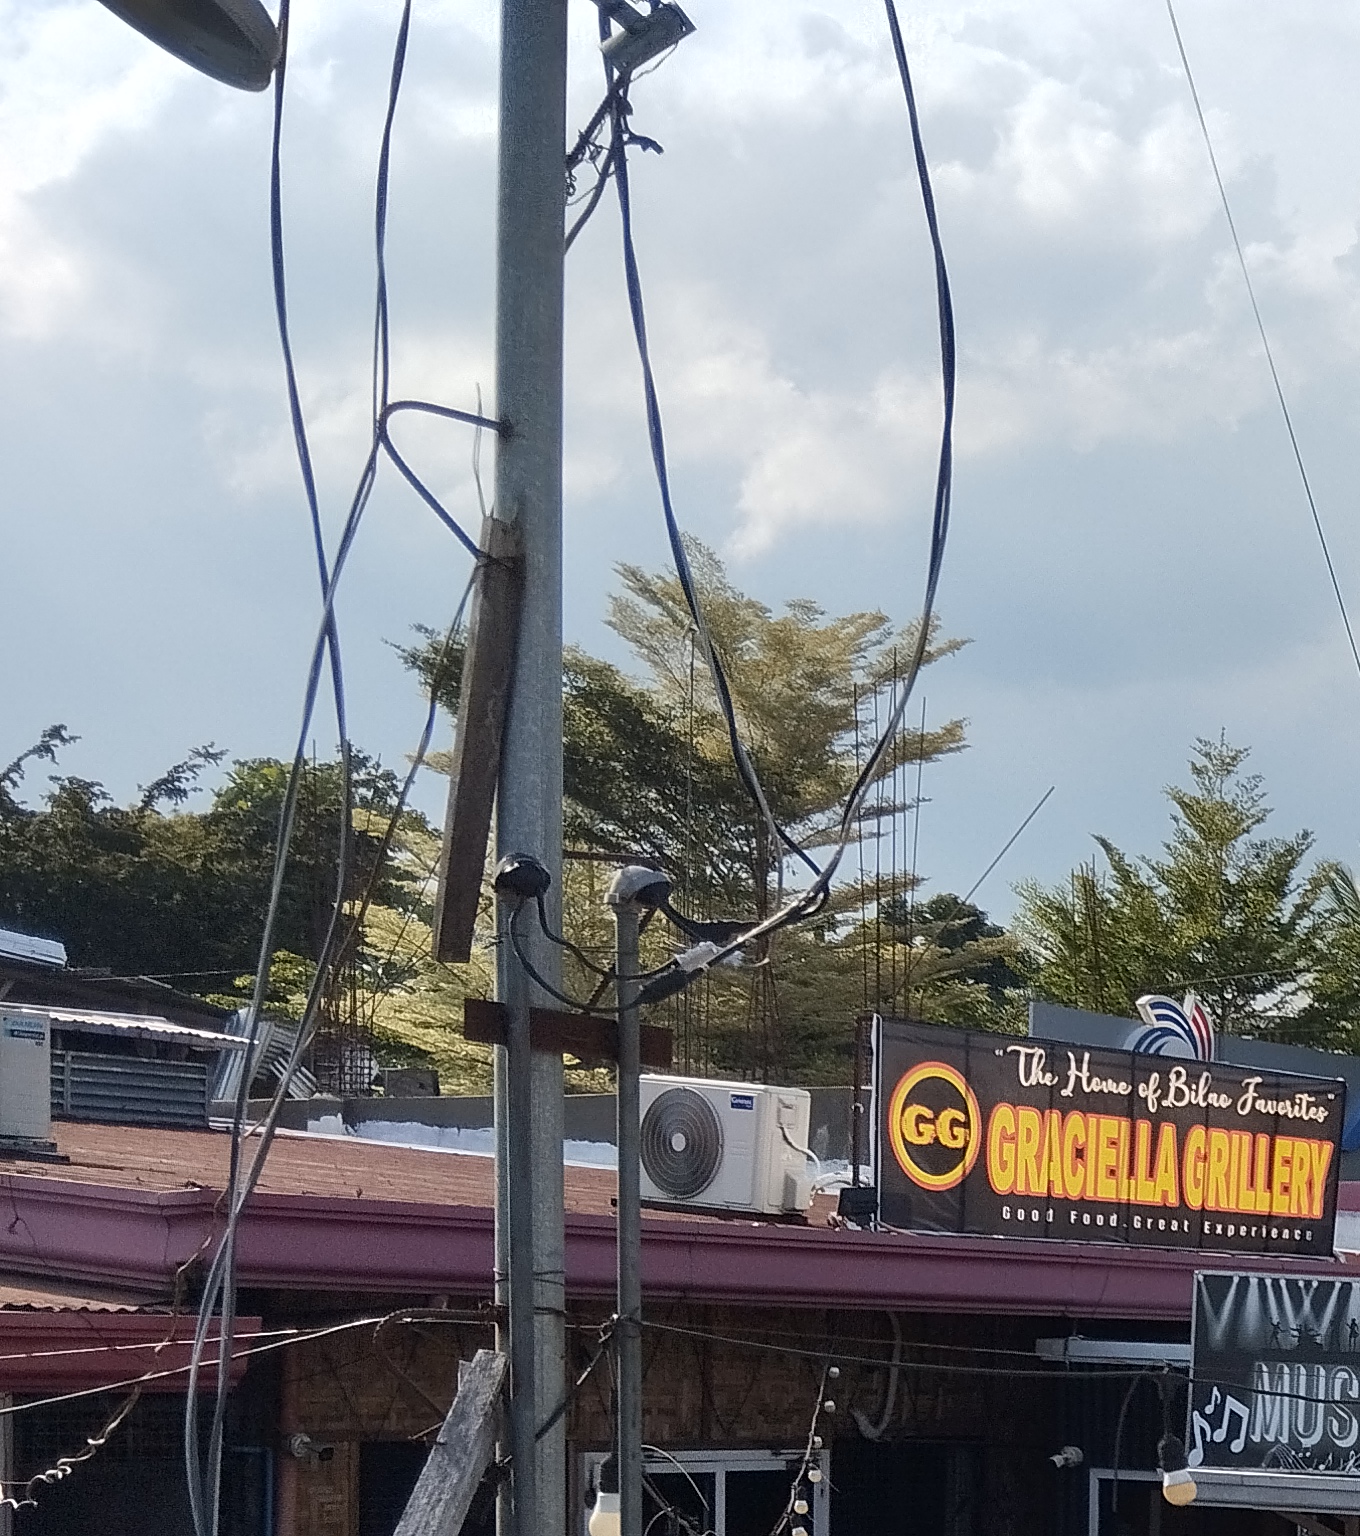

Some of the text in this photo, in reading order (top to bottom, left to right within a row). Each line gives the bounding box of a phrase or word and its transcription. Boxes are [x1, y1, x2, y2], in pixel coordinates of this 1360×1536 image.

[1138, 1072, 1160, 1112] of
[901, 1105, 970, 1149] GG
[987, 1102, 1334, 1219] GRACIELLA GRILLERY
[1002, 1205, 1054, 1224] Good
[1203, 1220, 1313, 1242] Experience
